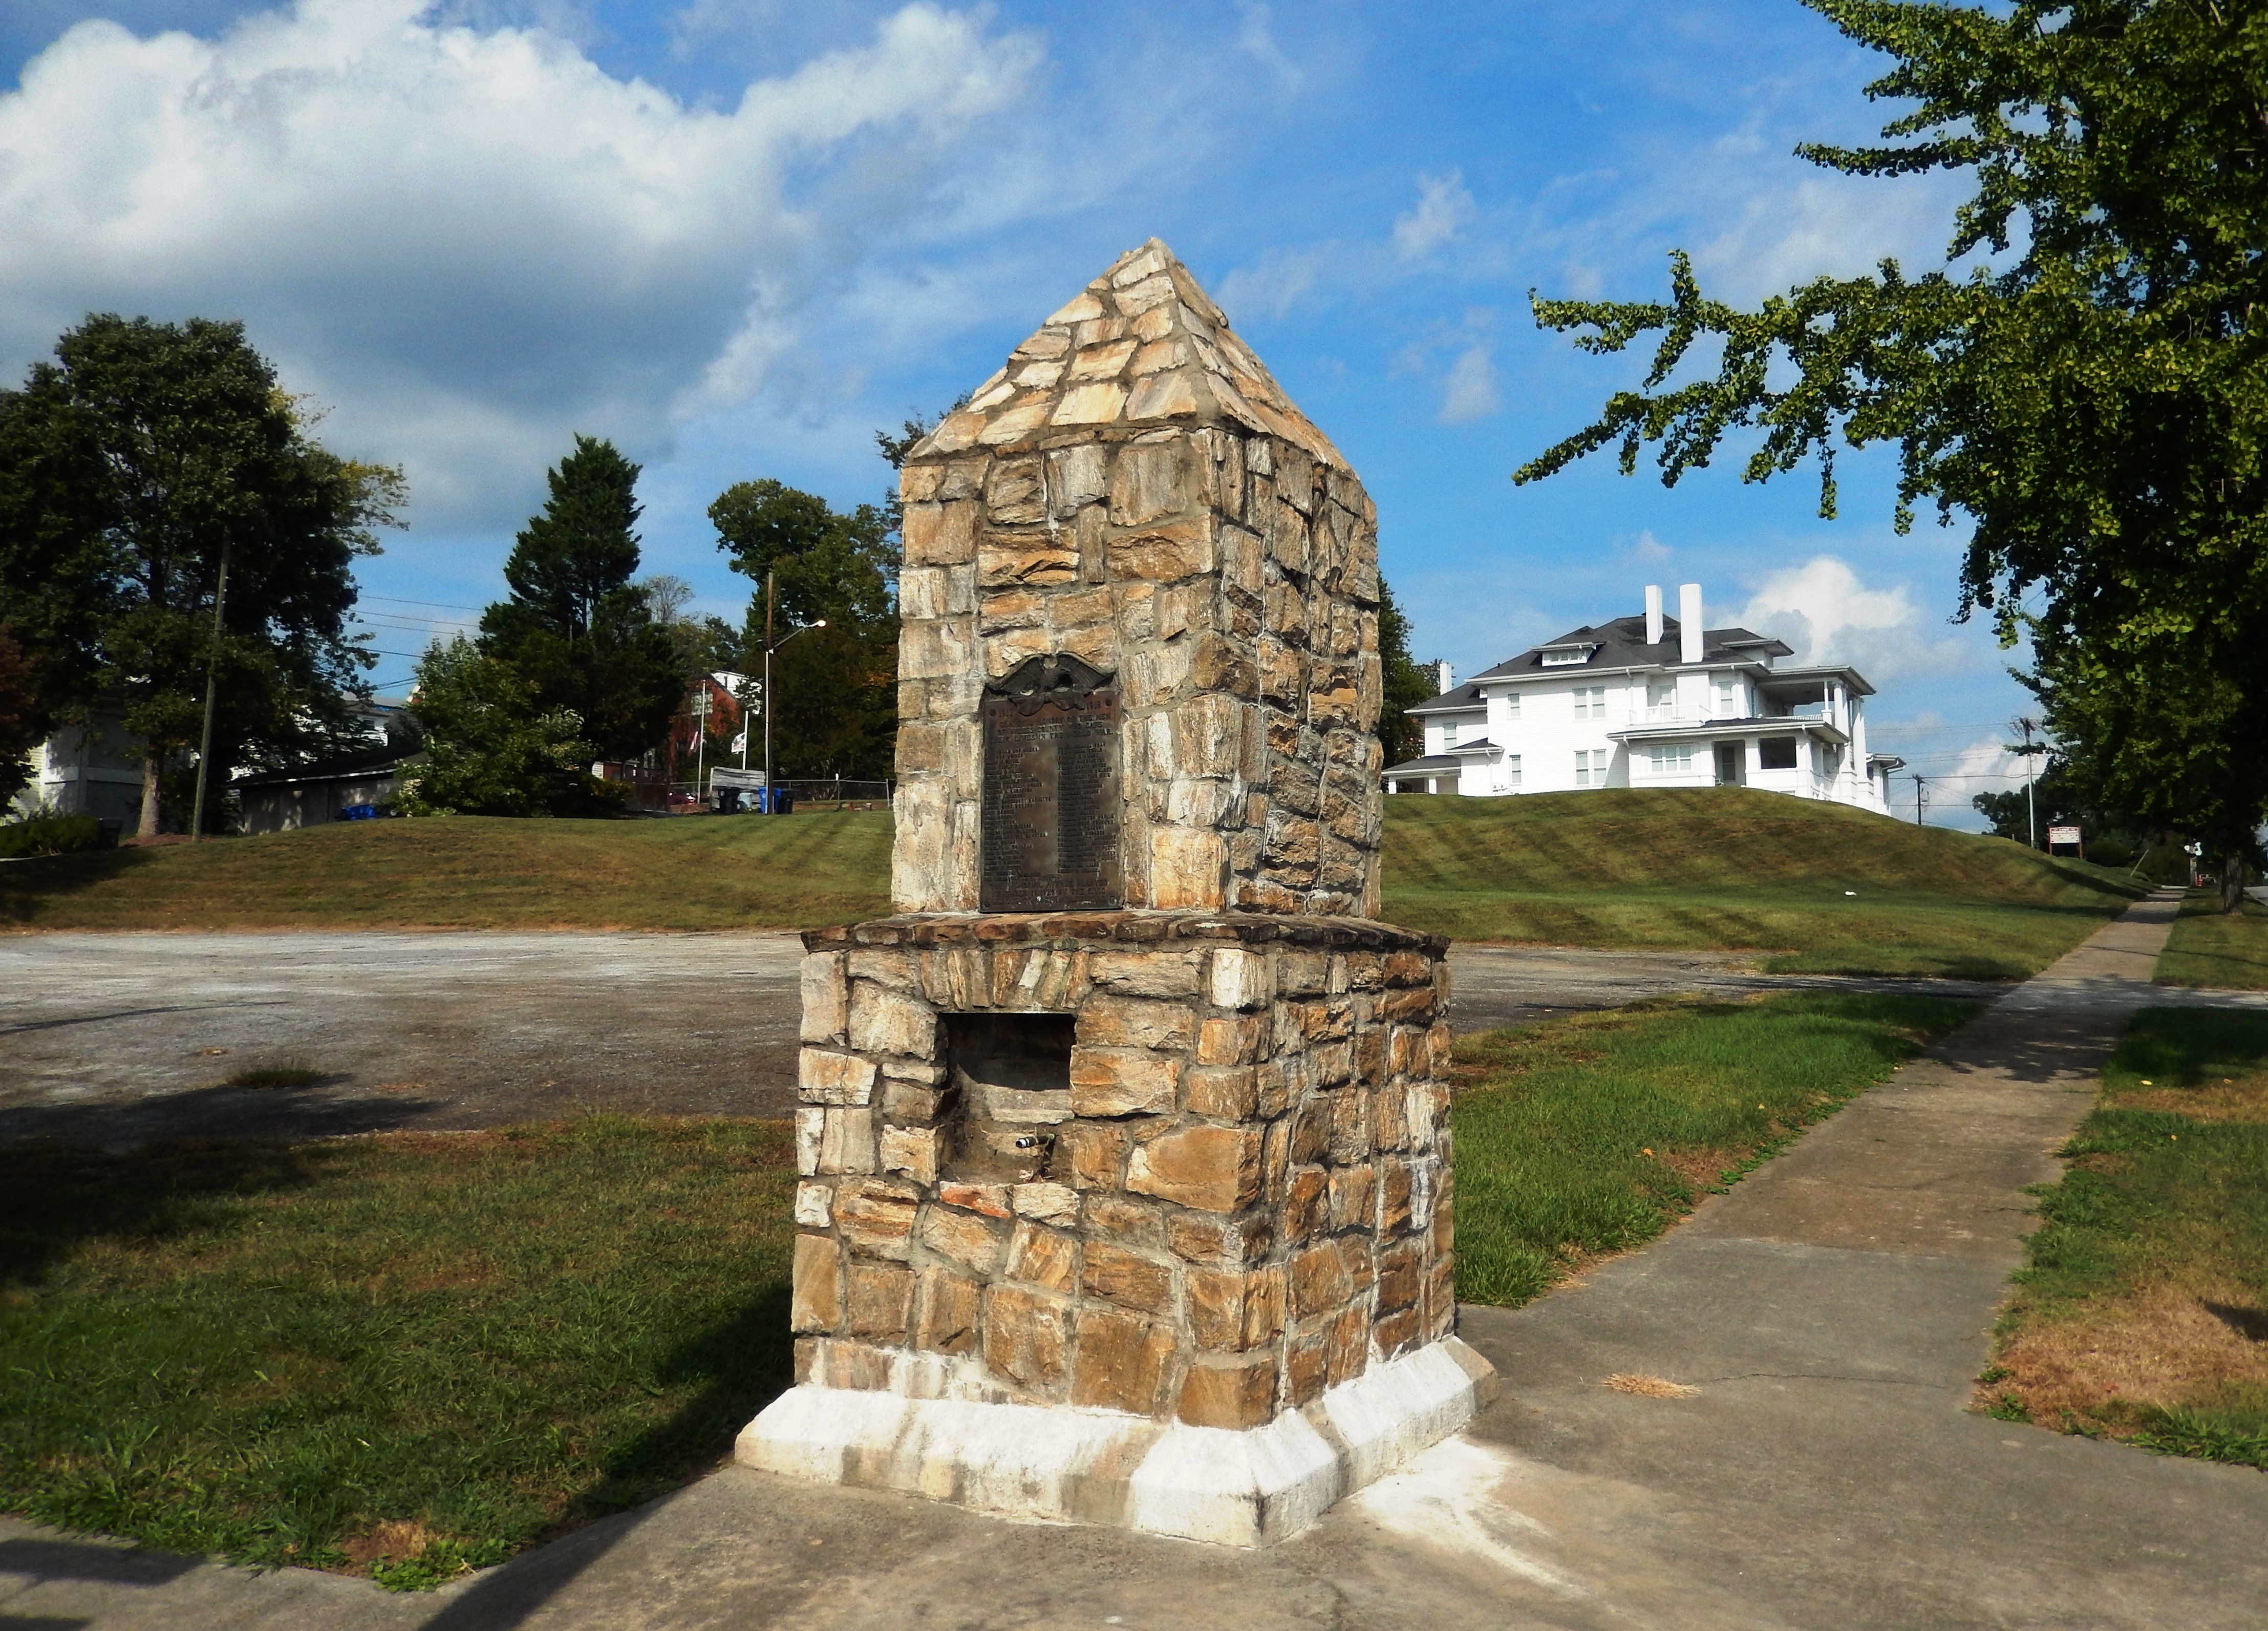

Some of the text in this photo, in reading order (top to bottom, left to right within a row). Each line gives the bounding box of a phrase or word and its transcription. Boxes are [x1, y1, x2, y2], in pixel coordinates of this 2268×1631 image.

[1096, 712, 1111, 721] MEN
[1038, 724, 1064, 733] COUNTY
[1069, 729, 1092, 737] ORLD
